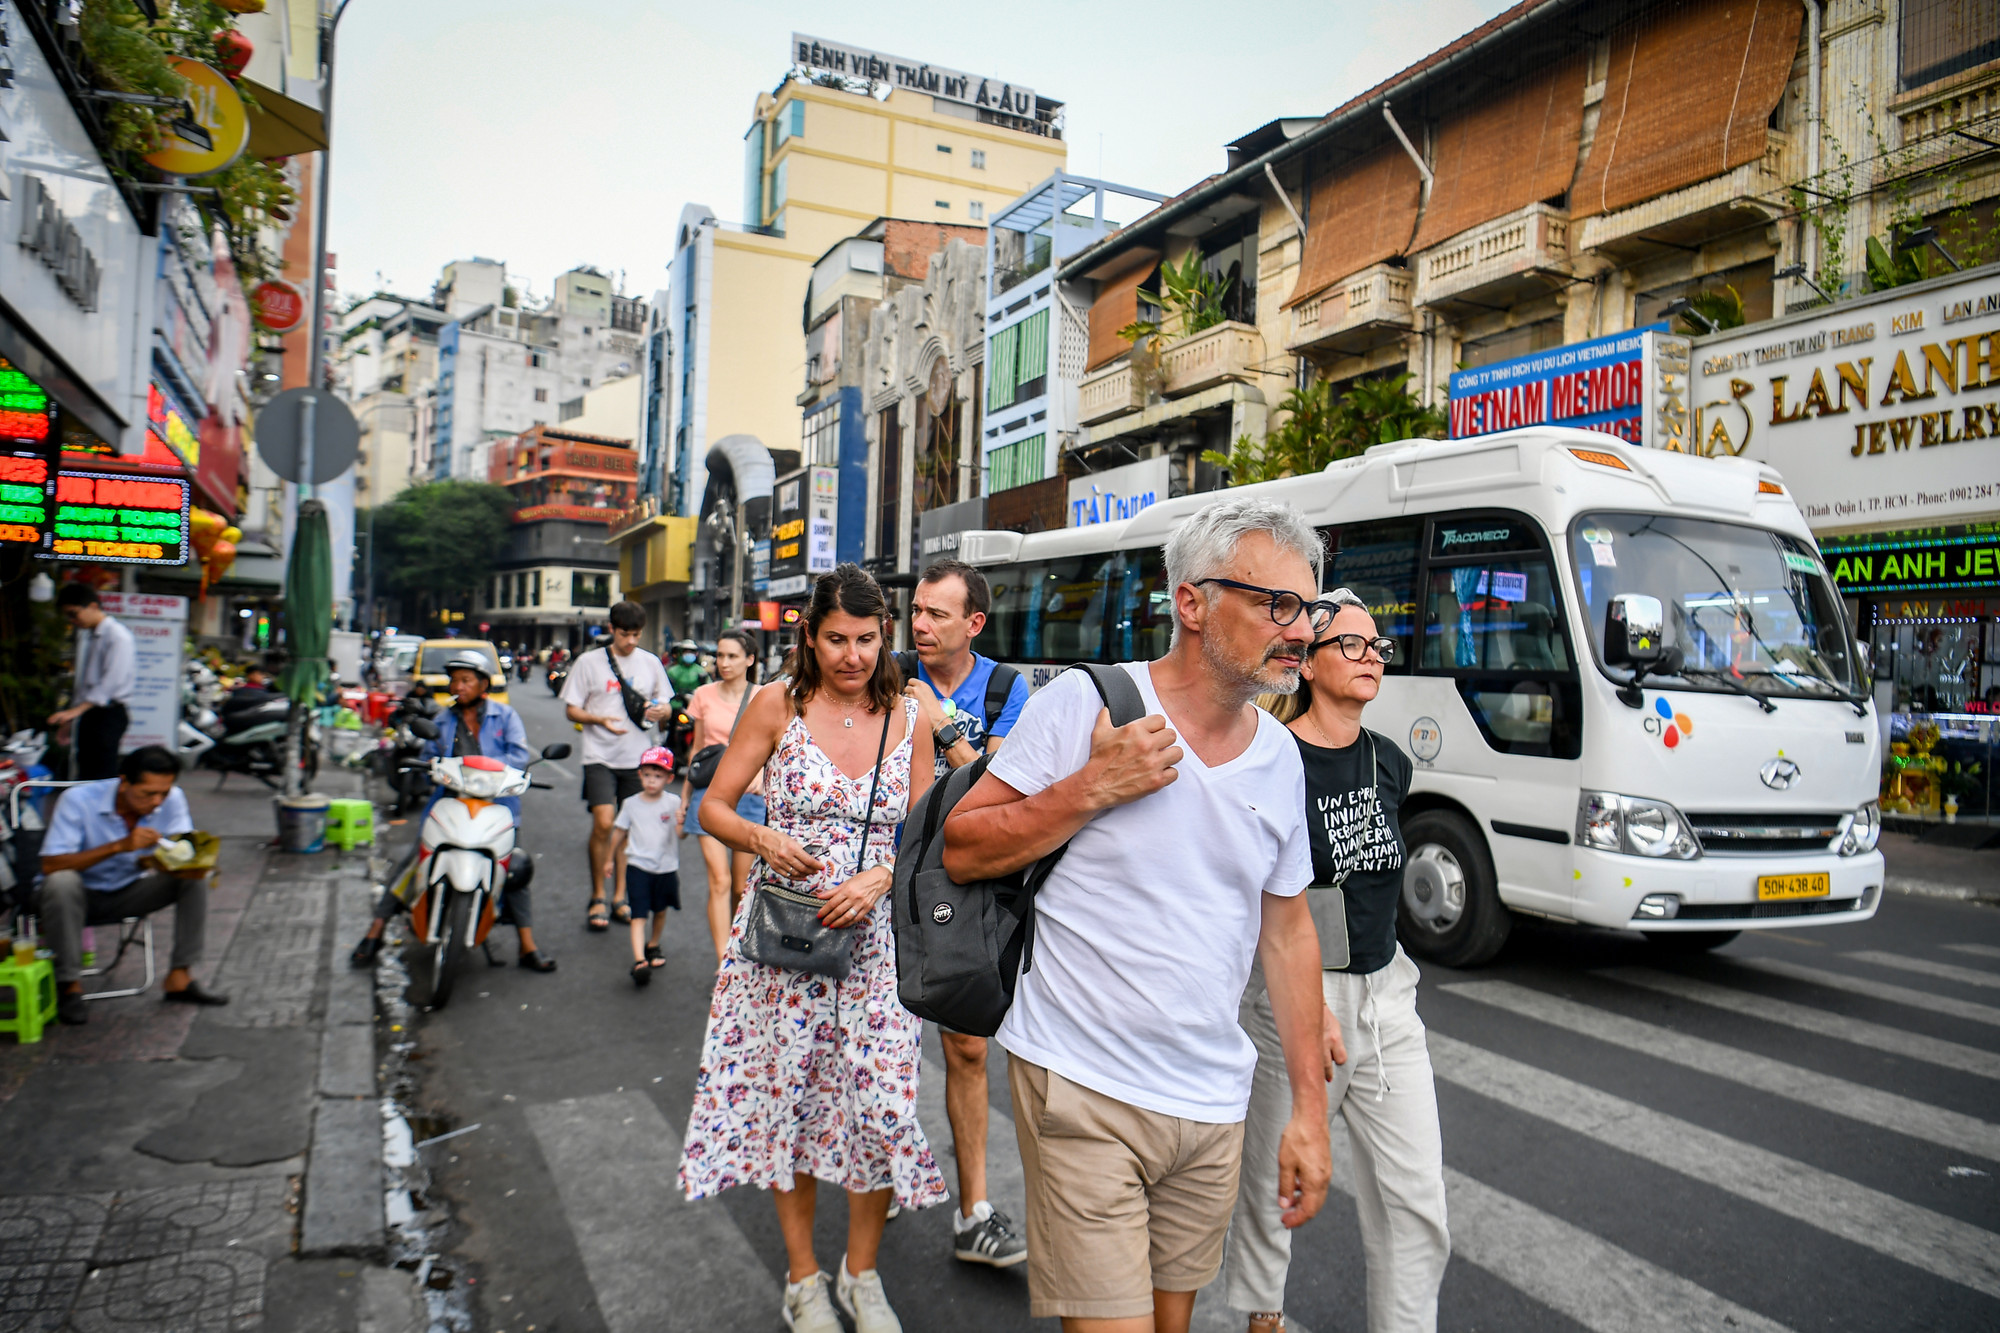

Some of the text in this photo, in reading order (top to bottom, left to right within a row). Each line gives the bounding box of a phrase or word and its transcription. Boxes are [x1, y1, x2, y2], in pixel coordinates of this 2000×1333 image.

[851, 54, 889, 81] VIỆN
[1736, 351, 1750, 367] TY
[1755, 343, 1786, 364] TNHH
[1789, 337, 1806, 357] TM
[1830, 322, 1875, 346] TRANG
[1892, 310, 1924, 335] KIM
[1943, 299, 1972, 322] LAN
[1977, 294, 2000, 315] AN
[1458, 374, 1478, 390] CÔNG
[1480, 372, 1490, 383] TY
[1492, 367, 1511, 382] TNHH
[1512, 362, 1531, 378] DỊCH
[1532, 359, 1543, 373] VỤ
[1544, 356, 1556, 369] DU
[1556, 352, 1576, 369] LỊCH
[1577, 342, 1616, 363] VIETNAM
[1769, 331, 2000, 425] LAN ANH
[1451, 379, 1548, 439] VIETNAM
[1851, 402, 2000, 458] JEWELRY
[566, 452, 599, 468] TACO
[1807, 505, 1830, 518] Thành
[1834, 502, 1856, 516] Quận
[1885, 494, 1908, 509] HCM
[1917, 491, 1947, 505] Phone:
[1950, 486, 1972, 501] 0902
[1975, 484, 1992, 498] 284
[1441, 529, 1510, 549] TRACOMECO
[1833, 555, 1872, 583] AN
[1881, 551, 1946, 581] ANH
[1643, 717, 1661, 736] CJ
[1317, 794, 1342, 811] UN
